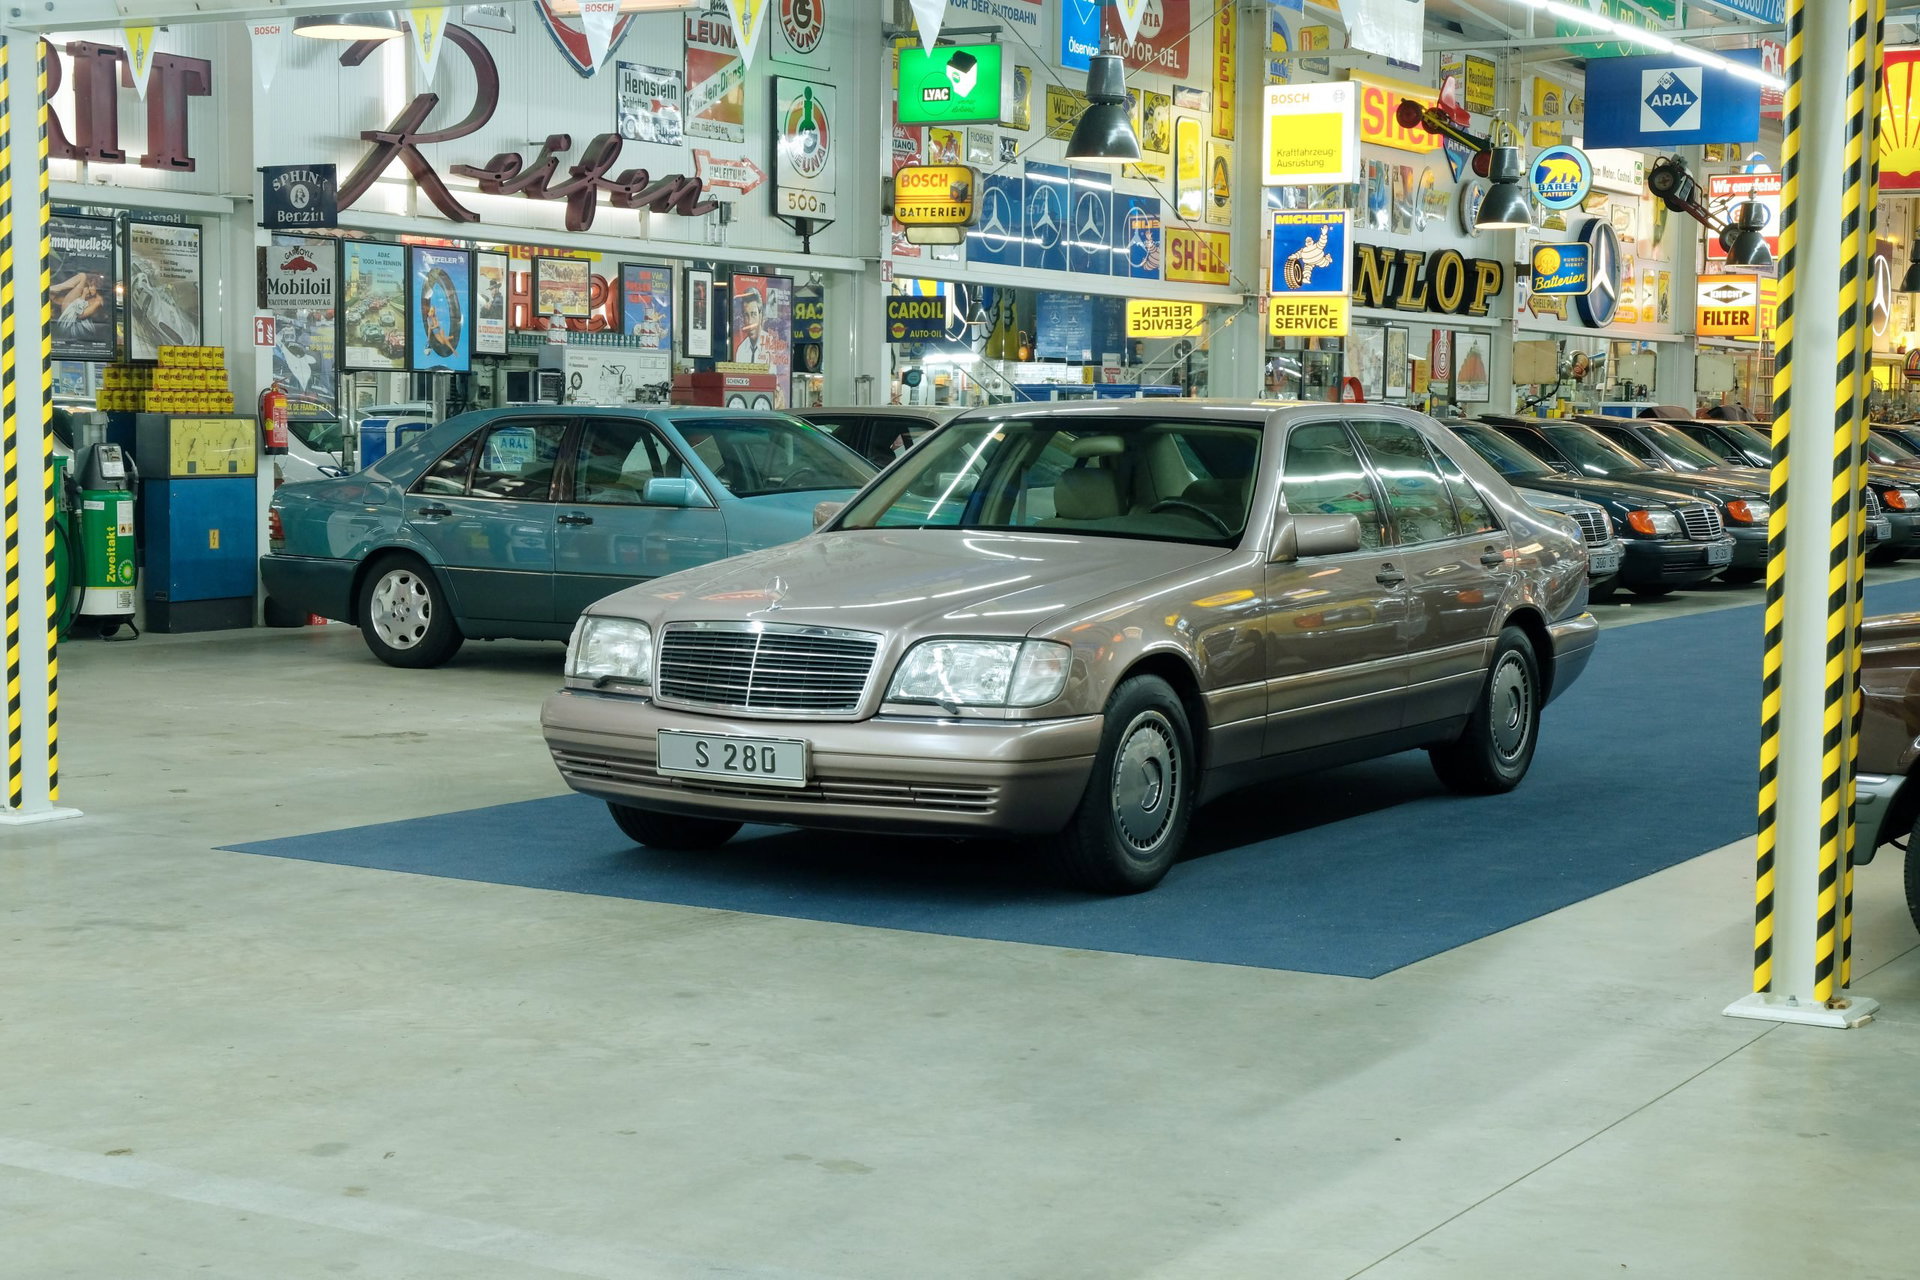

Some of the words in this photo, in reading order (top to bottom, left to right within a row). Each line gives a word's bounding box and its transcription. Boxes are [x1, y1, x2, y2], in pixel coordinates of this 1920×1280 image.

[584, 3, 614, 13] BOSCH
[972, 0, 989, 14] DER
[992, 3, 1037, 26] AUTOBAHN
[1142, 11, 1161, 28] VIA
[254, 26, 281, 36] BOSCH
[783, 16, 821, 48] LEUNA
[1068, 36, 1099, 56] Ölservice
[1112, 38, 1180, 69] MOTOR-OEL
[624, 72, 677, 100] Herbstein
[924, 88, 949, 101] LYAC
[1271, 93, 1310, 105] BOSCH
[1651, 93, 1692, 107] ARAL
[337, 22, 718, 232] Reifen
[892, 139, 915, 151] TANOL
[1276, 148, 1337, 159] Kraftfahrzeug-
[795, 147, 826, 174] EUNA
[901, 173, 949, 188] BOSCH
[1712, 178, 1731, 194] Wir
[1731, 177, 1780, 194] empfehle
[788, 192, 818, 212] 500
[818, 202, 827, 214] m
[900, 206, 967, 217] BATTERIEN
[277, 206, 325, 223] Benzin
[1275, 213, 1343, 225] MICHELIN
[1171, 237, 1226, 274] SHELL
[267, 277, 332, 296] Mobiloil
[1353, 243, 1503, 316] NLOP
[1533, 272, 1585, 291] Batterien
[888, 301, 944, 320] CAROIL
[1703, 310, 1750, 326] FILTER
[1275, 317, 1338, 329] SERVICE
[909, 329, 943, 338] AUTO-OIL
[501, 437, 529, 449] ARAL
[106, 525, 116, 583] Zweitakt
[696, 741, 710, 768] S
[724, 743, 777, 774] 280
